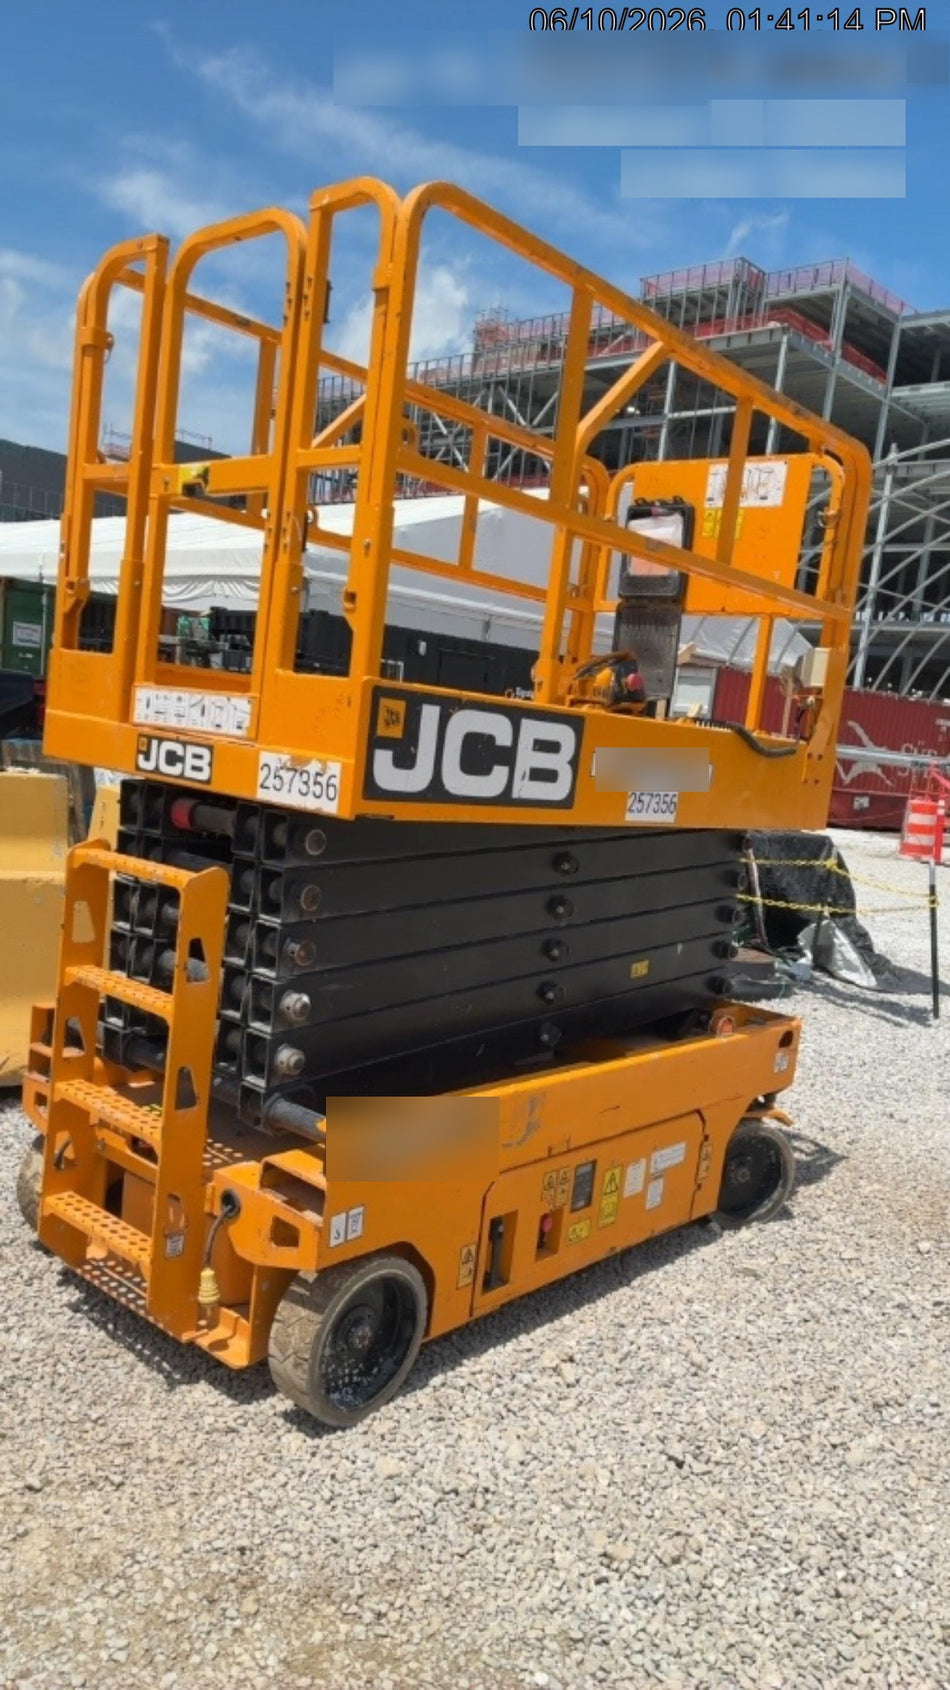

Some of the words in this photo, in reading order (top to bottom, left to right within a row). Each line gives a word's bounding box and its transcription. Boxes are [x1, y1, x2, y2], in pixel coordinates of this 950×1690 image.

[137, 738, 212, 782] JCB
[373, 703, 577, 801] JCB
[259, 763, 338, 802] 257356
[628, 792, 677, 814] 257356
